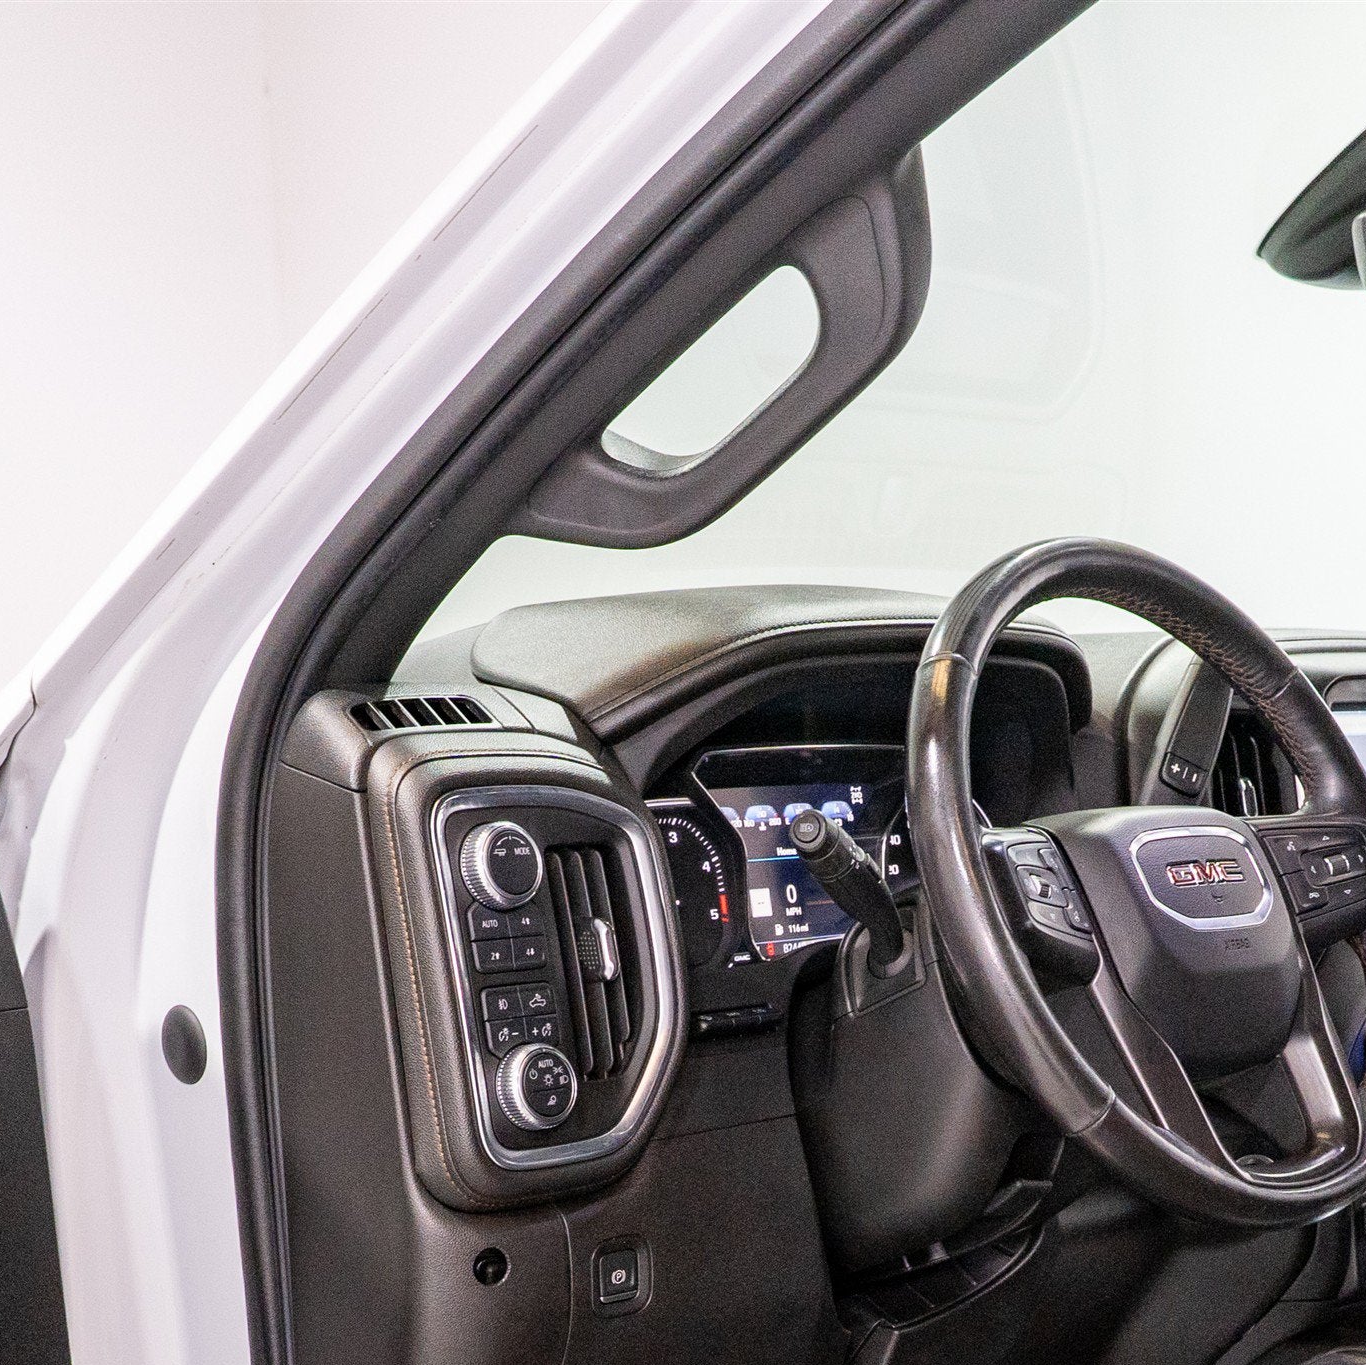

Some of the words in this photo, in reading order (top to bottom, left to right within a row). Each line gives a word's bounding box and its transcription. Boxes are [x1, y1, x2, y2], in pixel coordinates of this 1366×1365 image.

[668, 831, 678, 844] 3
[514, 847, 531, 856] MODE
[701, 860, 711, 873] 4
[1166, 860, 1245, 888] GMC
[786, 884, 798, 904] 0
[709, 908, 720, 921] 5
[785, 906, 803, 916] MPH
[481, 919, 499, 929] AUTO
[734, 954, 751, 962] GMC
[538, 1058, 554, 1069] AUTO
